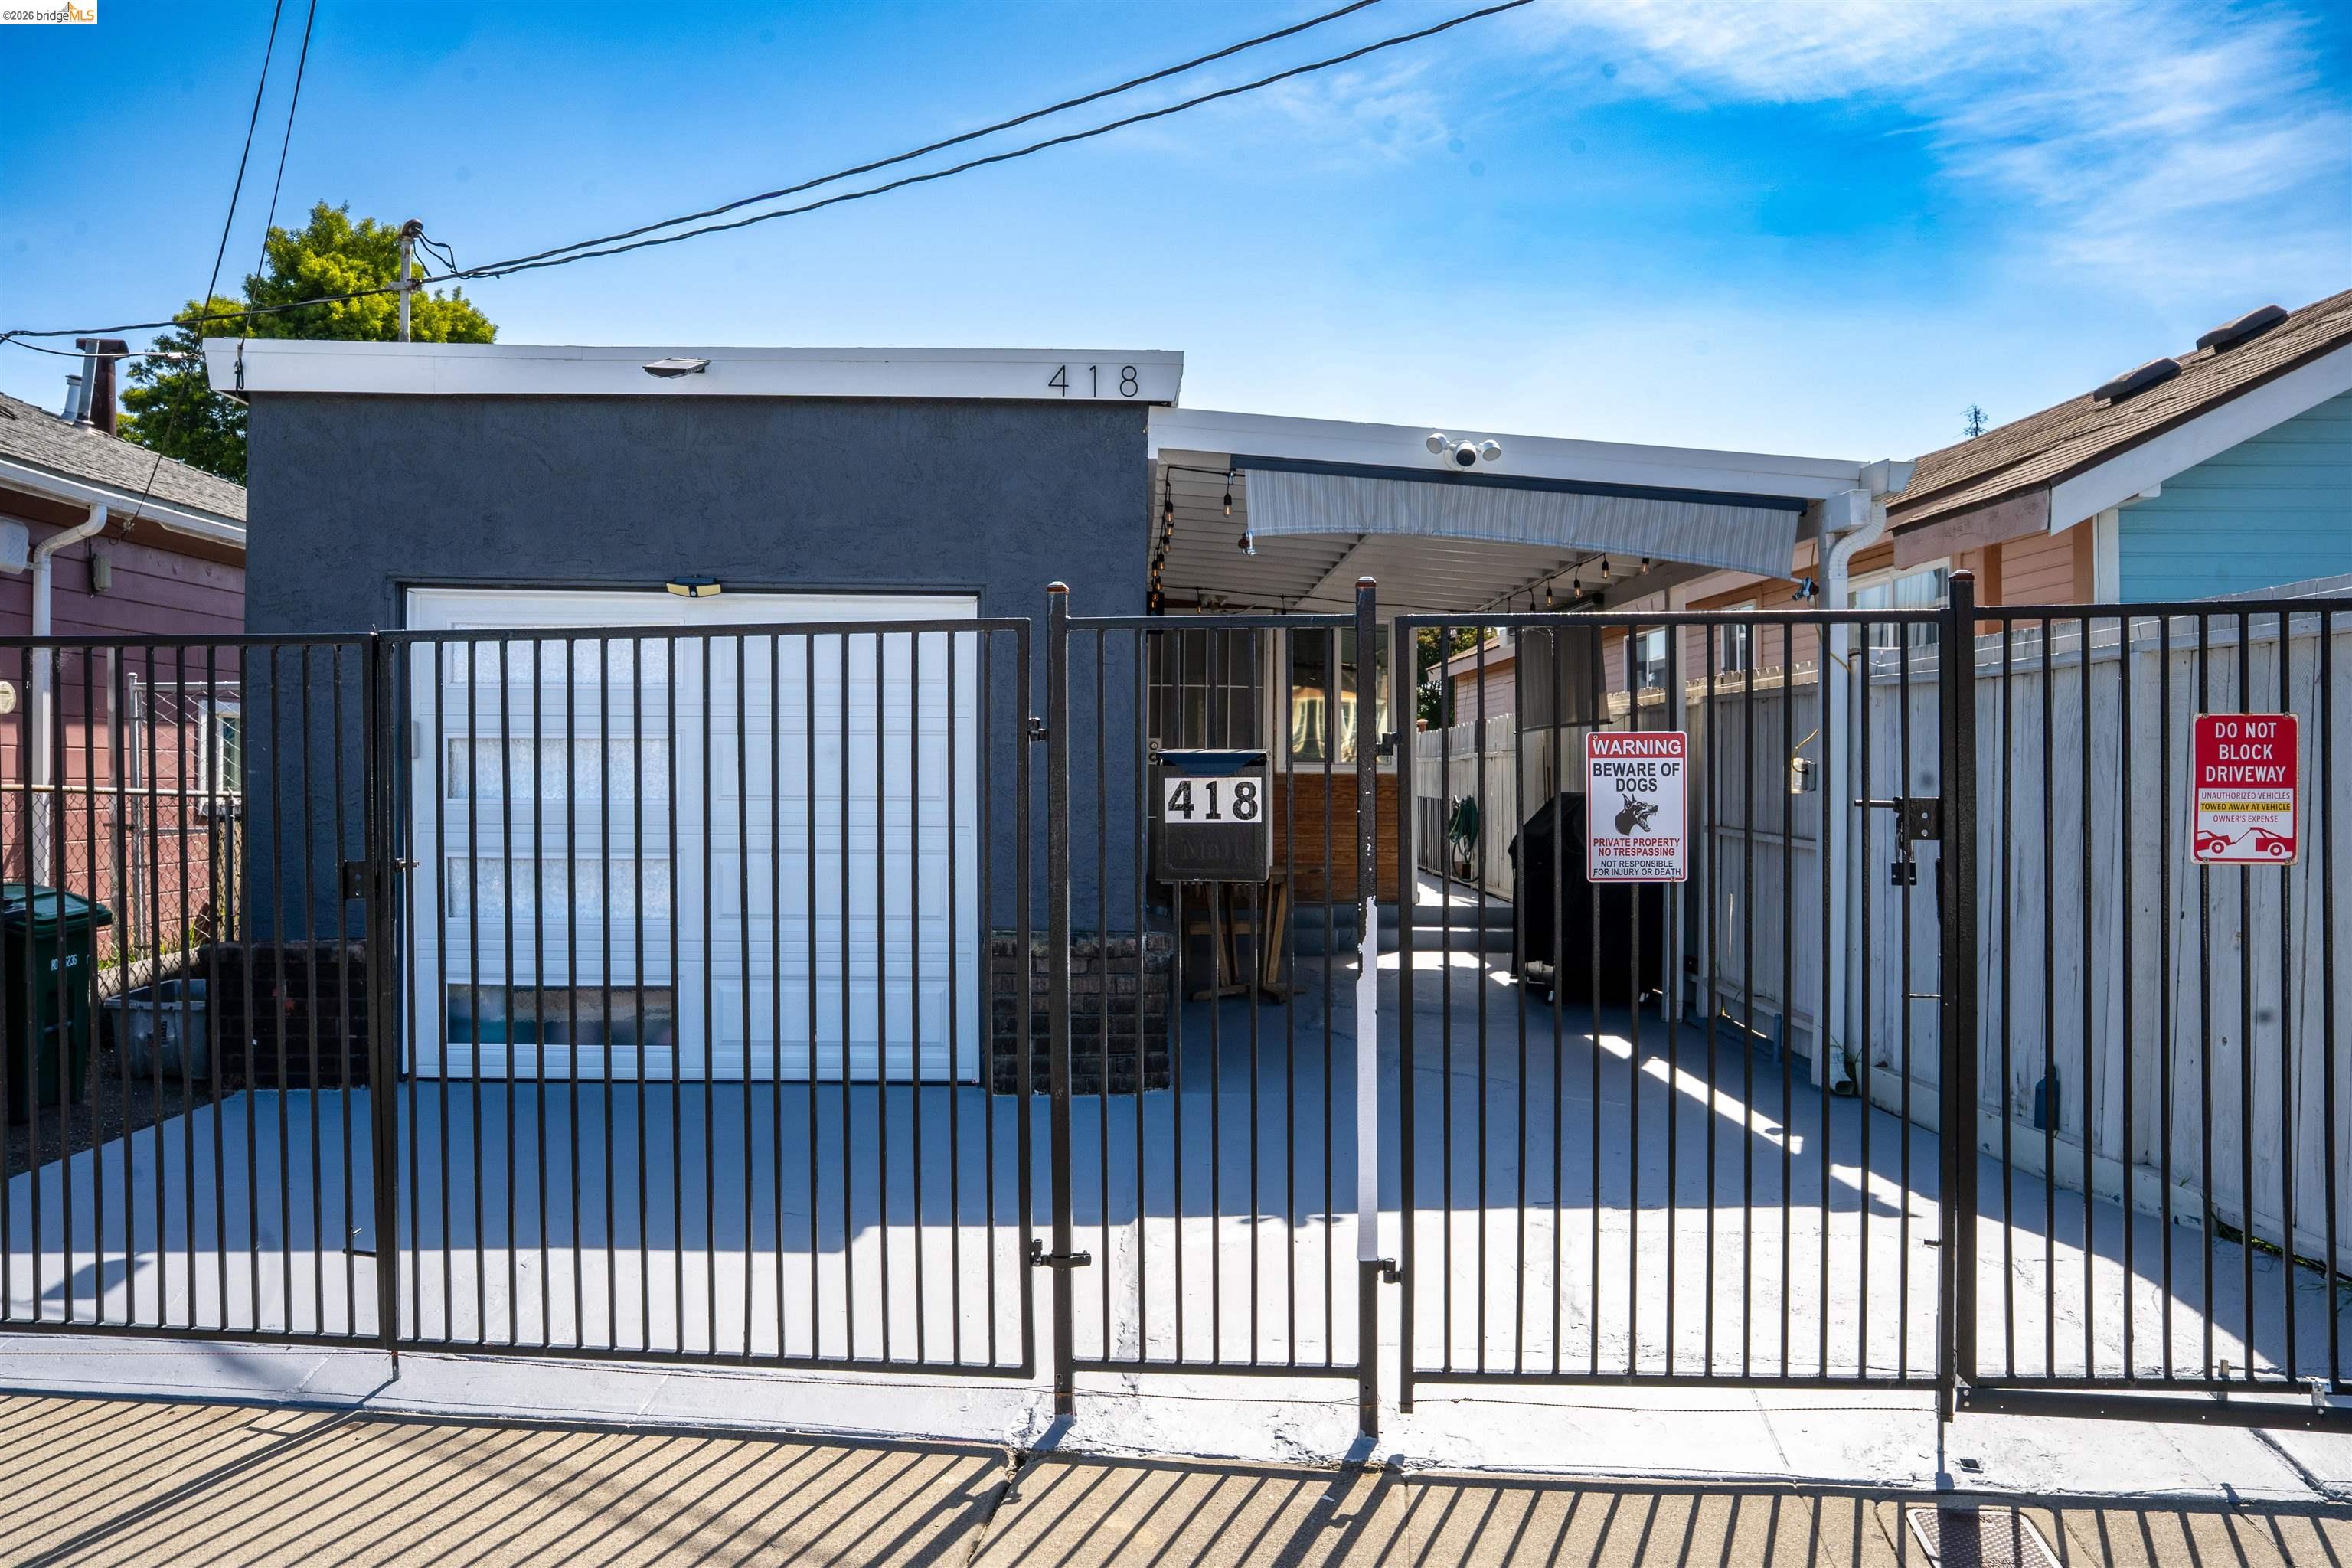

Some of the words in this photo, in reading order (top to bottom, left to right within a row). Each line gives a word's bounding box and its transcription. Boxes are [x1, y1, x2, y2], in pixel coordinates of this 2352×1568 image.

[1047, 364, 1138, 398] 418
[2215, 722, 2238, 739] DO
[2245, 722, 2277, 739] NOT
[1592, 739, 1682, 755] WARNING
[2219, 744, 2273, 760] BLOCK
[1592, 763, 1656, 777] BEWARE
[1661, 763, 1681, 777] OF
[2205, 766, 2286, 782] DRIVEWAY
[1616, 778, 1658, 792] DOGS
[1168, 780, 1258, 821] 418
[2201, 792, 2256, 800] UNAUTHORIZED
[2258, 792, 2291, 800] VEHICLES
[2213, 815, 2246, 823] OWNER'S
[2248, 815, 2278, 823] EXPENSE
[1593, 838, 1631, 847] PRIVATE
[1633, 838, 1681, 847] PROPERTY
[1599, 848, 1611, 857] NO
[1615, 848, 1675, 857] TRESPASSING
